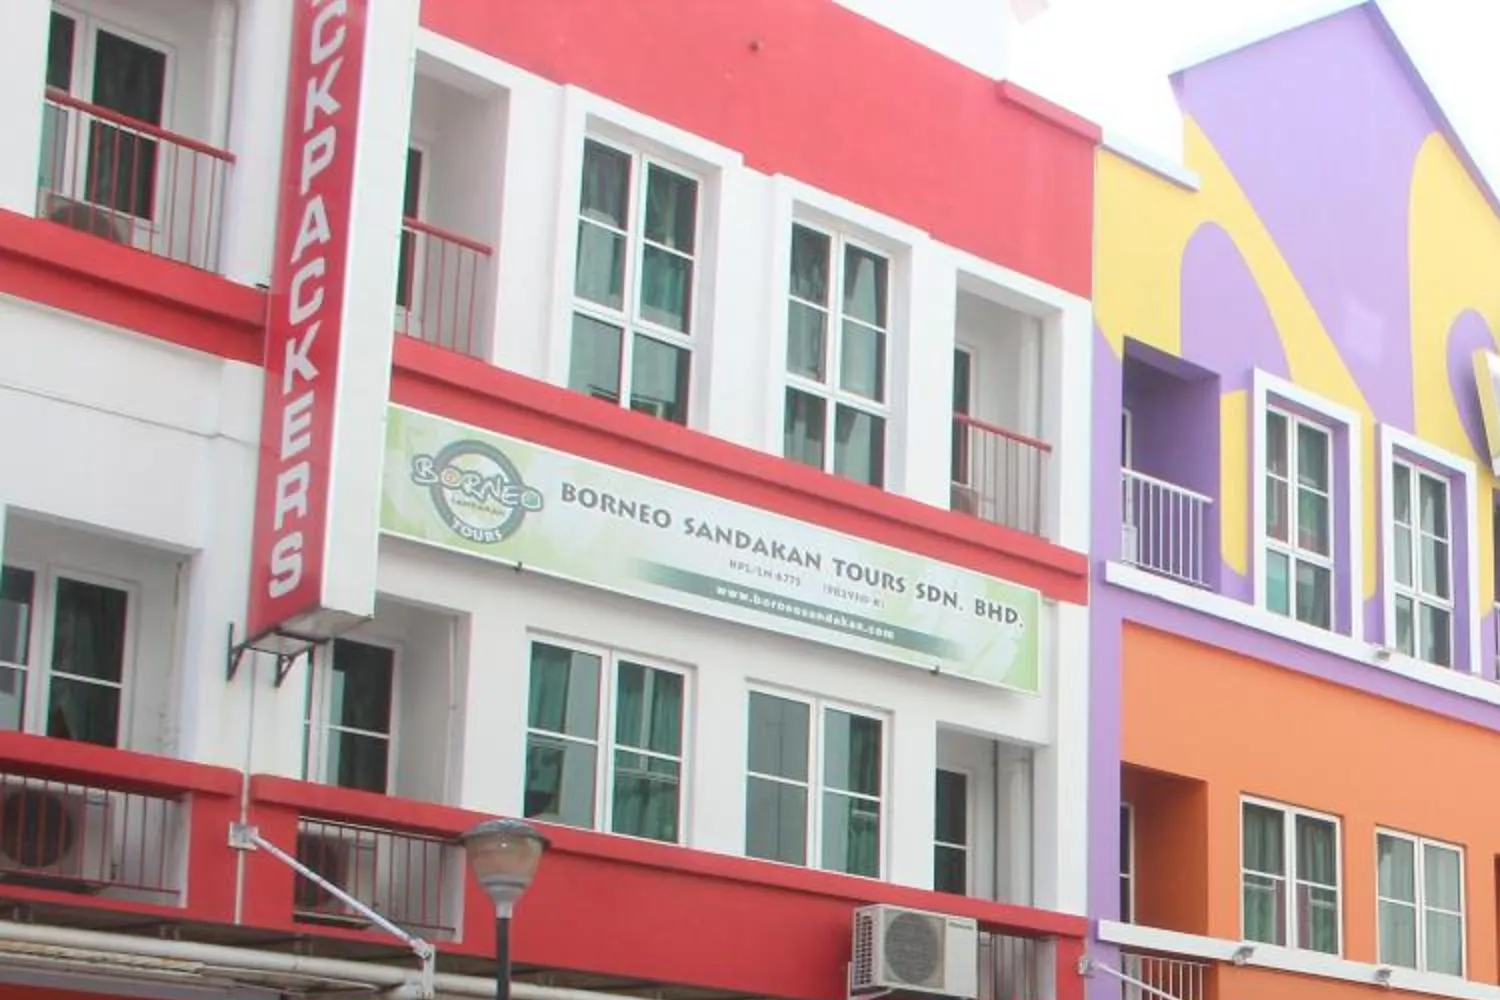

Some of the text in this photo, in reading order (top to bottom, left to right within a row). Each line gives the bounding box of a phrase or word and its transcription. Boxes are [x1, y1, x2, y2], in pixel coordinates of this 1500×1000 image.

[268, 0, 347, 599] CKPACKERS
[411, 453, 543, 512] BORNEO
[561, 482, 672, 529] BORNEO
[684, 517, 823, 571] SANDAKAN
[832, 558, 906, 593] TOURS
[915, 582, 964, 611] SDN.
[974, 598, 1024, 628] BHD.
